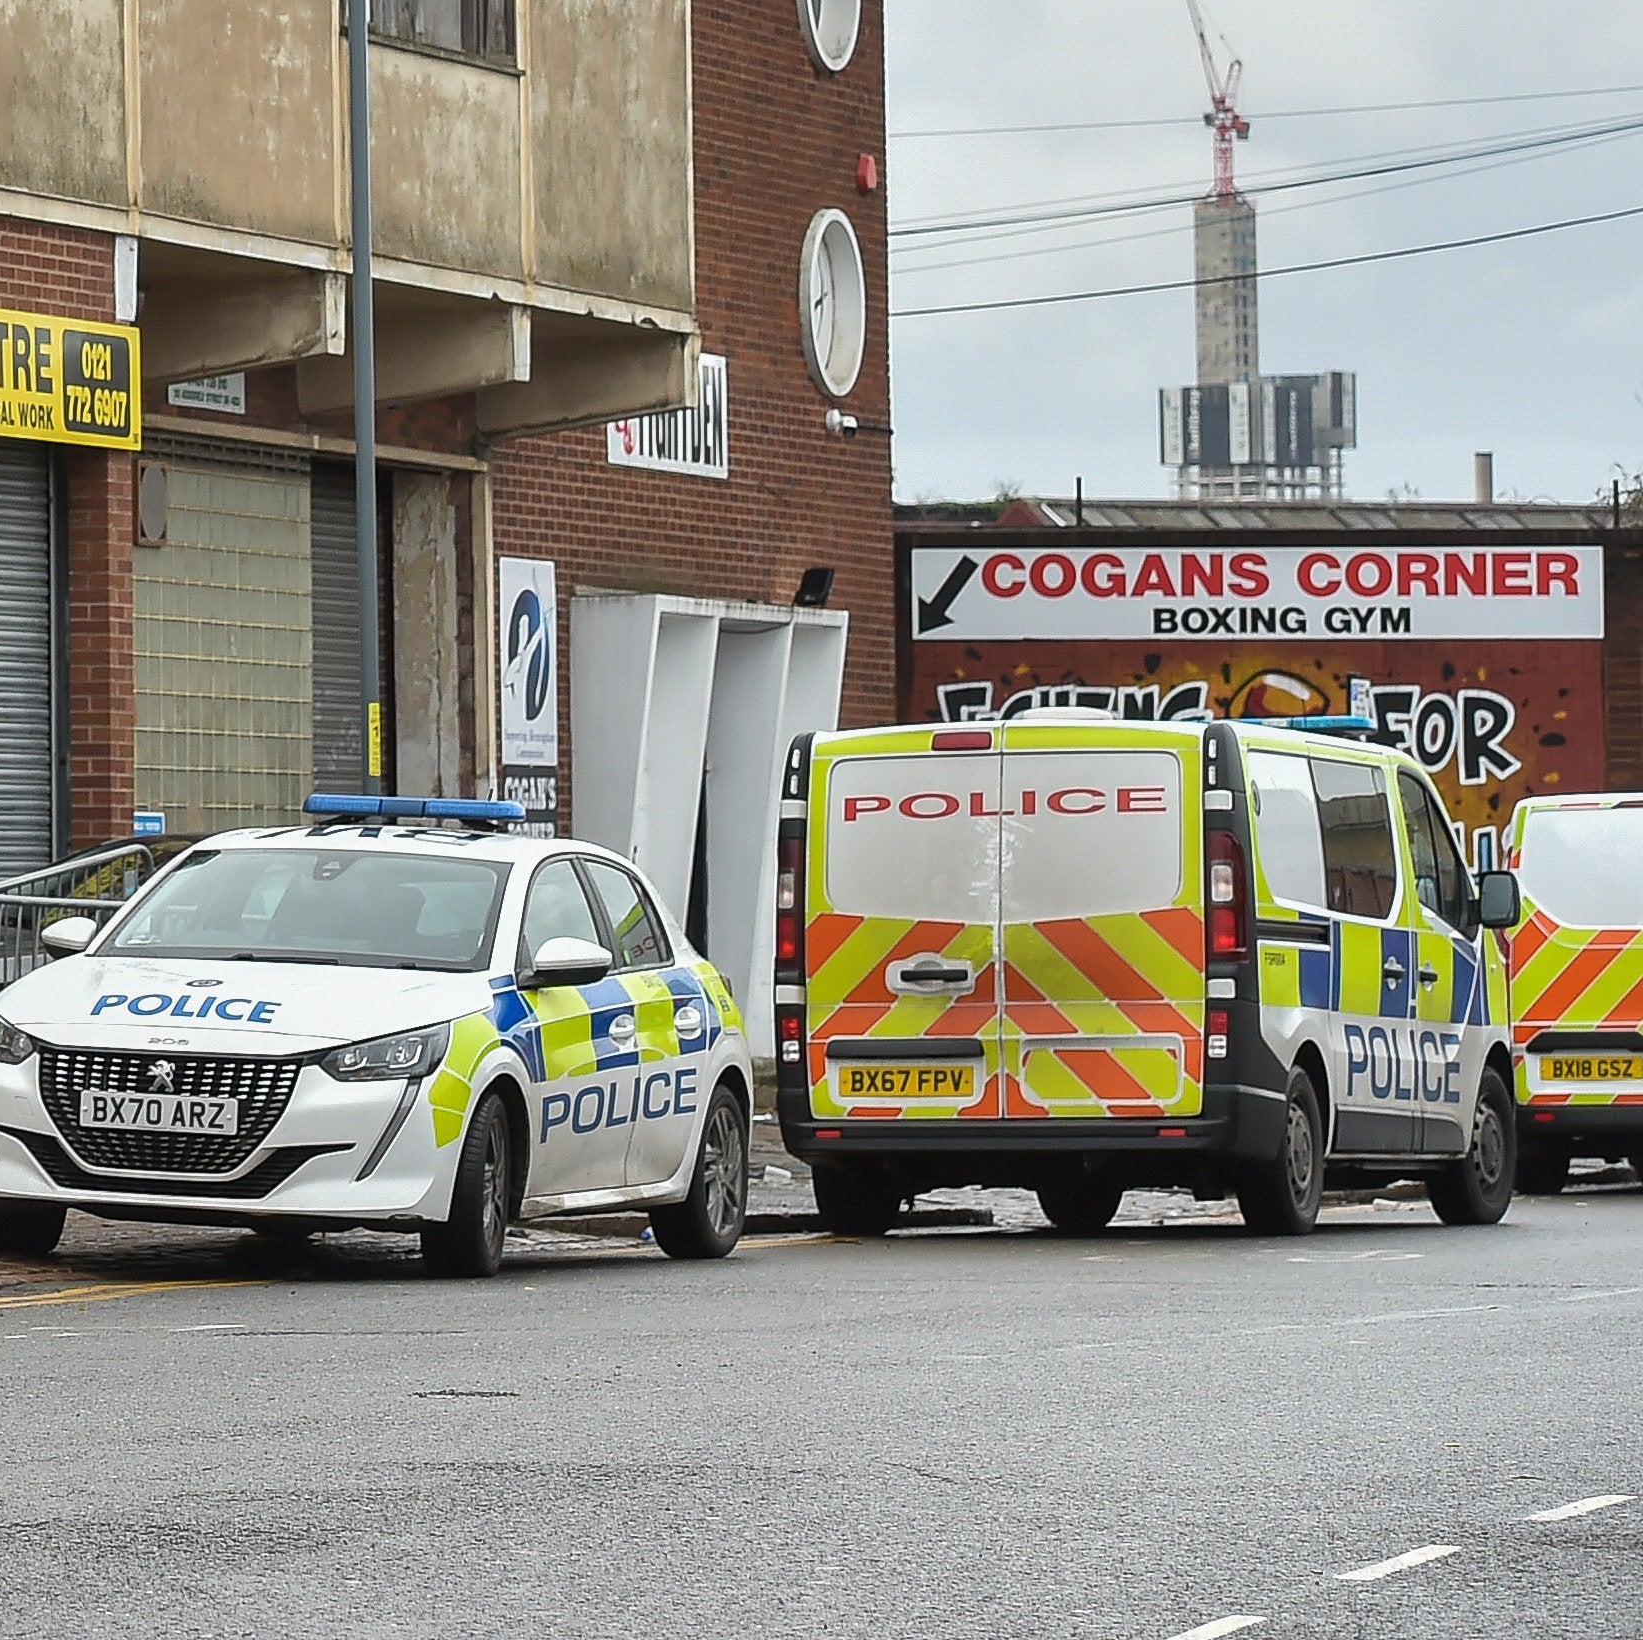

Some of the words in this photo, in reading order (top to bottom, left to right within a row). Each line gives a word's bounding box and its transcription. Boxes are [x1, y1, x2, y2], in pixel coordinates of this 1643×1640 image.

[81, 340, 112, 381] 0121
[18, 401, 55, 431] WORK
[66, 384, 92, 424] 772
[94, 388, 127, 428] 6907
[980, 553, 1269, 599] COGANS
[1297, 553, 1579, 598] CORNER
[1153, 606, 1307, 635] BOXING
[1325, 606, 1412, 635] GYM
[1365, 685, 1522, 785] FOR
[843, 786, 1167, 823] POLICE
[90, 994, 282, 1024] POLICE
[850, 1070, 911, 1092] BX67
[917, 1070, 964, 1092] FPV
[1344, 1023, 1461, 1103] POLICE
[1552, 1060, 1591, 1079] BX18
[1597, 1060, 1633, 1079] GSZ
[92, 1096, 162, 1126] BX70
[170, 1101, 226, 1130] ARZ
[540, 1068, 697, 1144] POLICE
